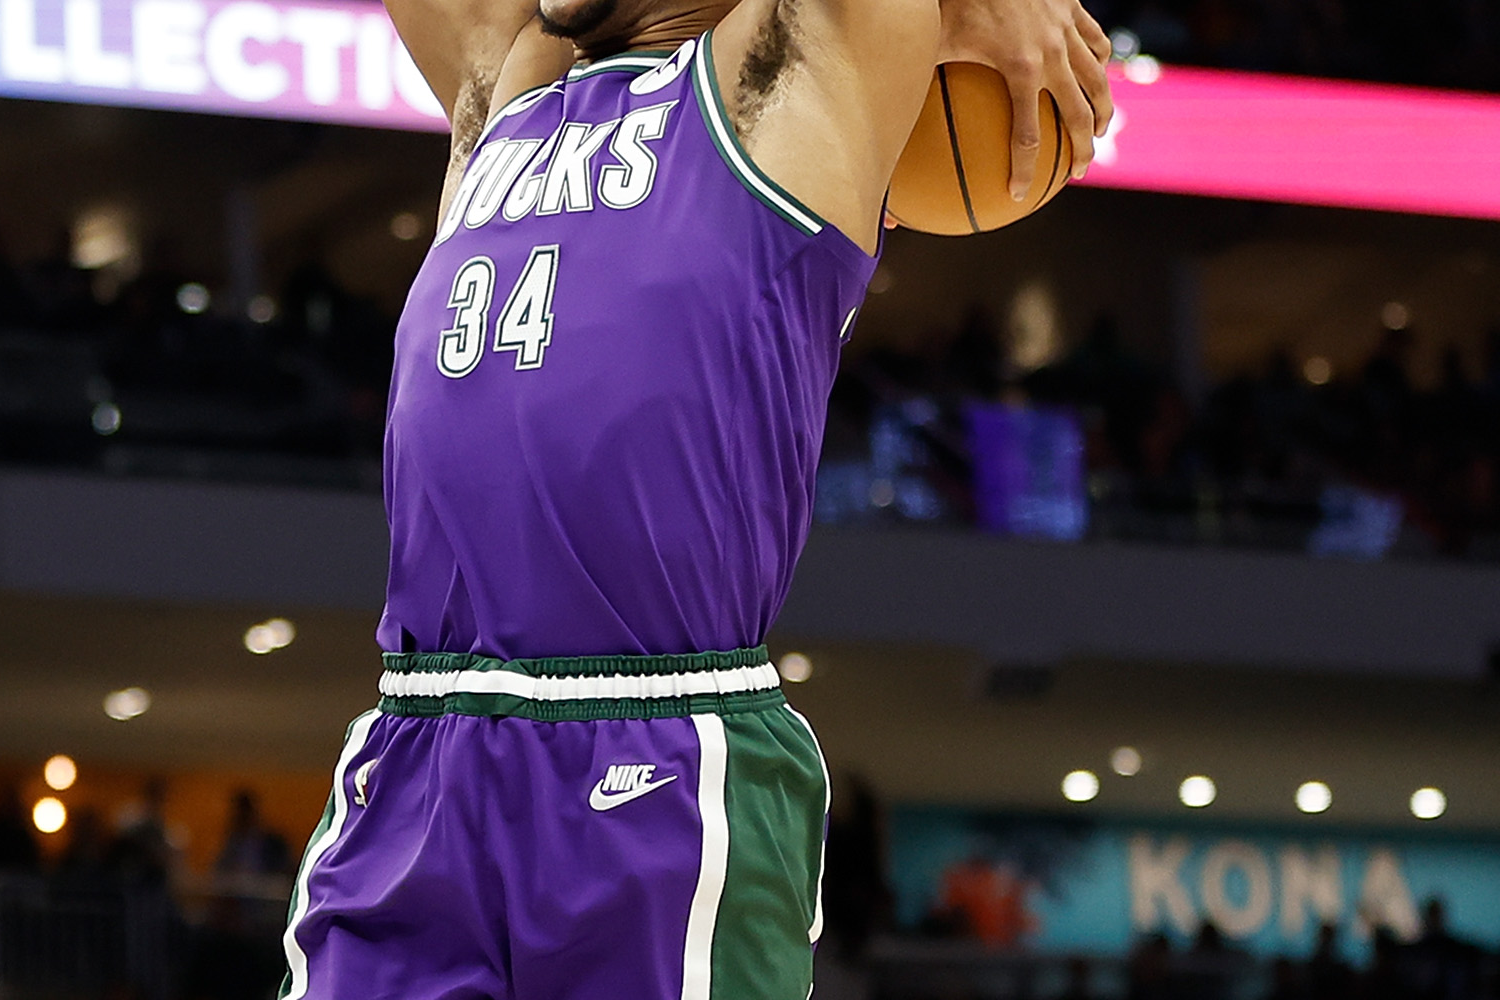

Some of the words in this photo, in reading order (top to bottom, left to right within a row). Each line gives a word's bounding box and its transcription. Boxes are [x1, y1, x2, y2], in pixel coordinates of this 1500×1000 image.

[436, 243, 560, 379] 34
[601, 764, 657, 792] NIKE
[1129, 834, 1423, 944] KONA
